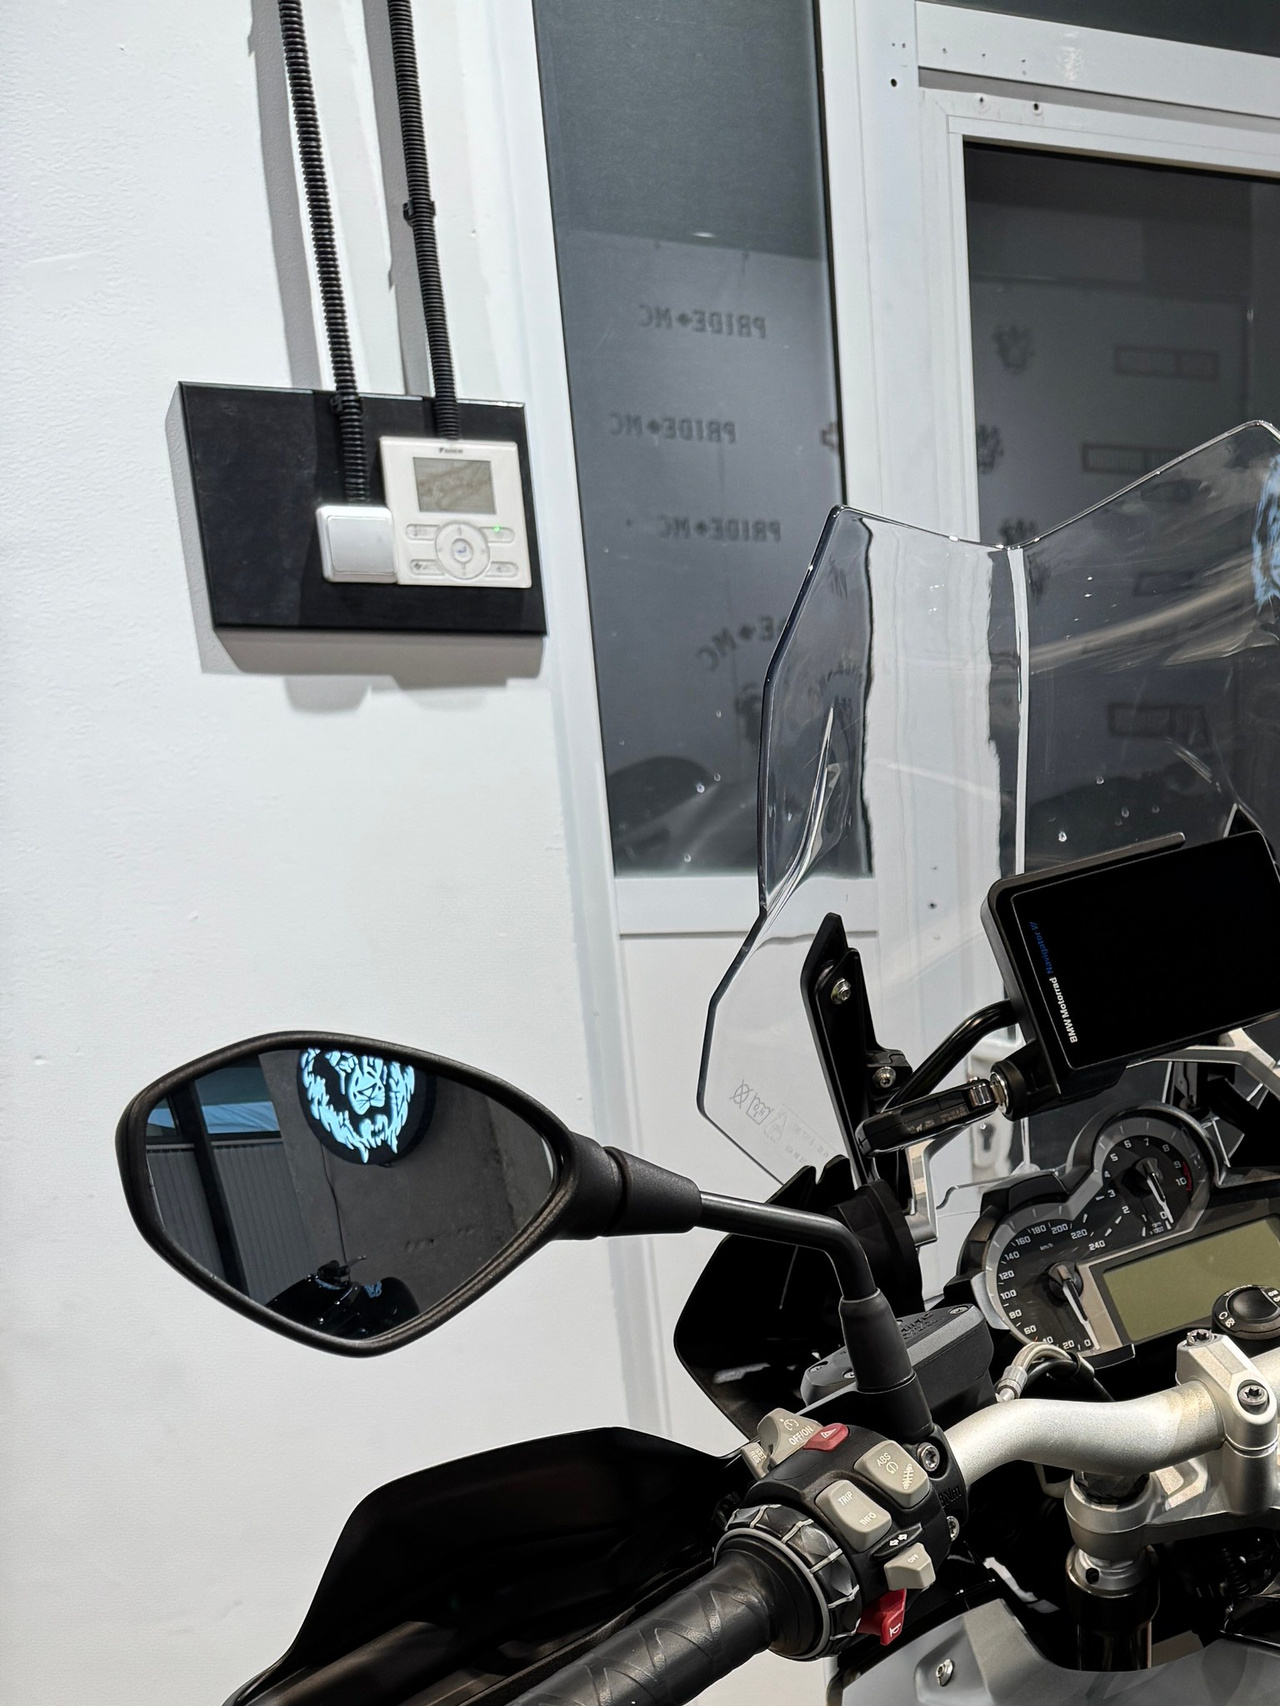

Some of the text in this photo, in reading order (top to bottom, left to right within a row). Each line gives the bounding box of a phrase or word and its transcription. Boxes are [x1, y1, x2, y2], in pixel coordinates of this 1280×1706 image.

[1034, 931, 1054, 975] Navigator
[1049, 976, 1070, 1019] Motorrad
[1063, 1018, 1078, 1044] BMW
[1123, 1139, 1132, 1149] 6
[1143, 1137, 1149, 1147] 7
[1162, 1144, 1170, 1152] 8
[1109, 1153, 1119, 1162] 5
[1173, 1160, 1182, 1169] 9
[1175, 1177, 1187, 1187] 10
[1107, 1189, 1116, 1198] 3
[1121, 1205, 1131, 1214] 2
[1031, 1225, 1047, 1235] 180
[1051, 1223, 1069, 1235] 200
[1070, 1229, 1088, 1240] 220
[1015, 1235, 1031, 1246] 160
[1088, 1239, 1106, 1251] 240
[1004, 1251, 1020, 1261] 140
[998, 1270, 1015, 1280] 120
[1000, 1289, 1017, 1300] 100
[1008, 1309, 1022, 1320] 80
[1023, 1324, 1037, 1335] 60
[1062, 1340, 1075, 1350] 20
[1083, 1338, 1092, 1347] 0
[876, 1452, 891, 1467] ABS
[838, 1491, 854, 1506] TRIP
[859, 1511, 877, 1526] INFO
